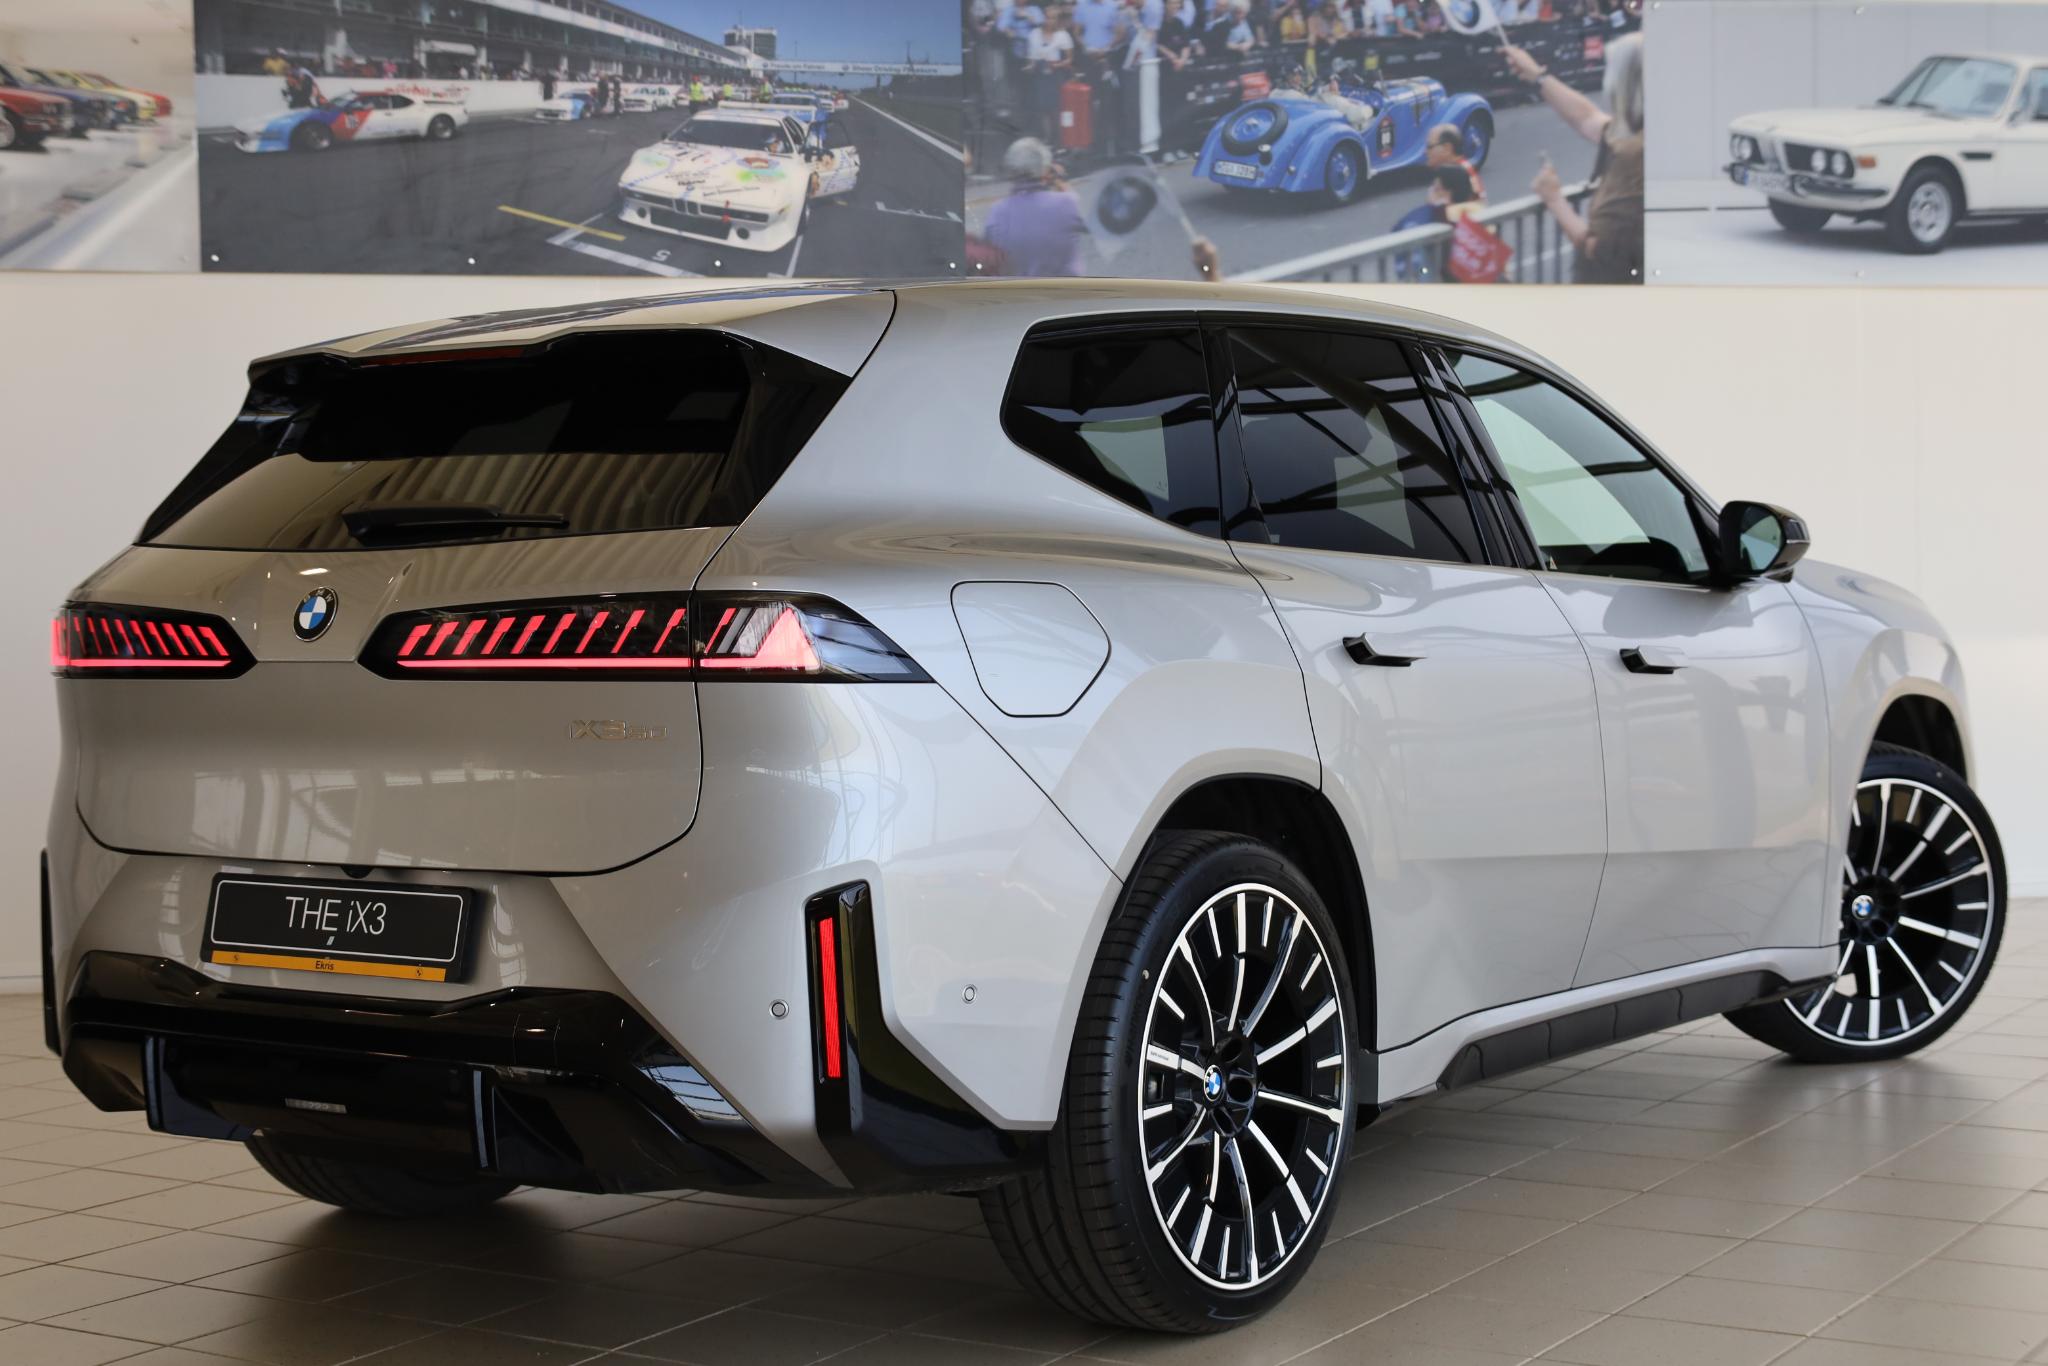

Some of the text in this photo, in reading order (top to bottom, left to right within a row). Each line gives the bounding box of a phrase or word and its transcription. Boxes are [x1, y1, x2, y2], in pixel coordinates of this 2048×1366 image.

[285, 896, 387, 935] THE iX3
[315, 960, 335, 971] Ekris
